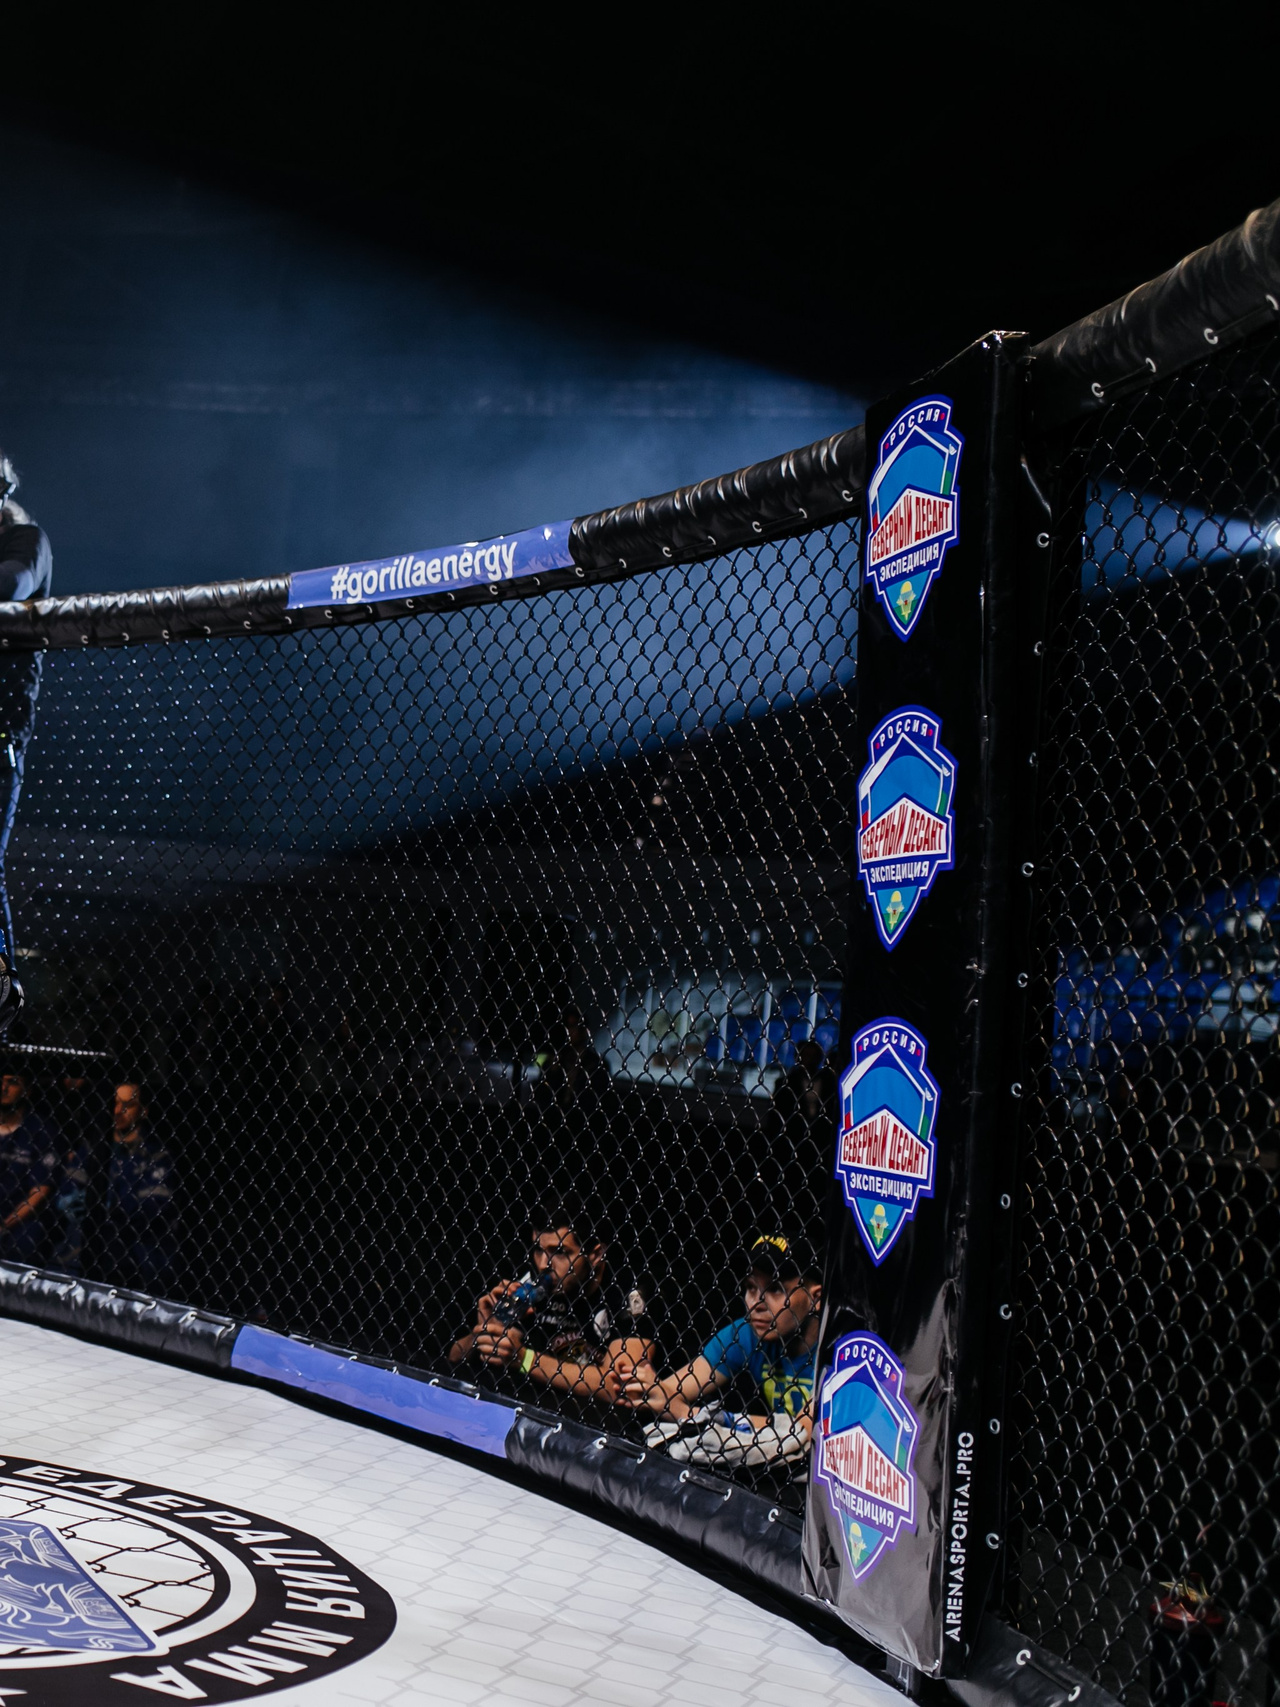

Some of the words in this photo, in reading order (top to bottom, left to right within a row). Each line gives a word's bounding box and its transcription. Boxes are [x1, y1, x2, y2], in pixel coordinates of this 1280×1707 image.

[889, 408, 941, 446] РОССИЯ
[871, 491, 914, 563] СЕВЕРНЫЙ
[914, 495, 950, 543] ДЕСАНТ
[330, 541, 518, 604] #gorillaenergy
[879, 542, 940, 583] ЭКСПЕДИЦИЯ
[879, 718, 929, 748] РОССИЯ
[861, 800, 908, 861] СЕВЕРНЫЙ
[903, 807, 944, 851] ДЕСАНТ
[870, 860, 930, 884] ЭКСПЕДИЦИЯ
[862, 1030, 917, 1056] РОССИЯ
[843, 1112, 890, 1169] СЕВЕРНЫЙ
[888, 1123, 927, 1176] ДЕСАНТ
[850, 1173, 914, 1201] ЭКСПЕДИЦИЯ
[844, 1345, 892, 1379] РОССИЯ
[825, 1430, 865, 1488] СЕВЕРНЫЙ
[865, 1443, 907, 1508] ДЕСАНТ
[945, 1432, 974, 1643] ARENASPORTA.PRO
[109, 1620, 355, 1700] ММА
